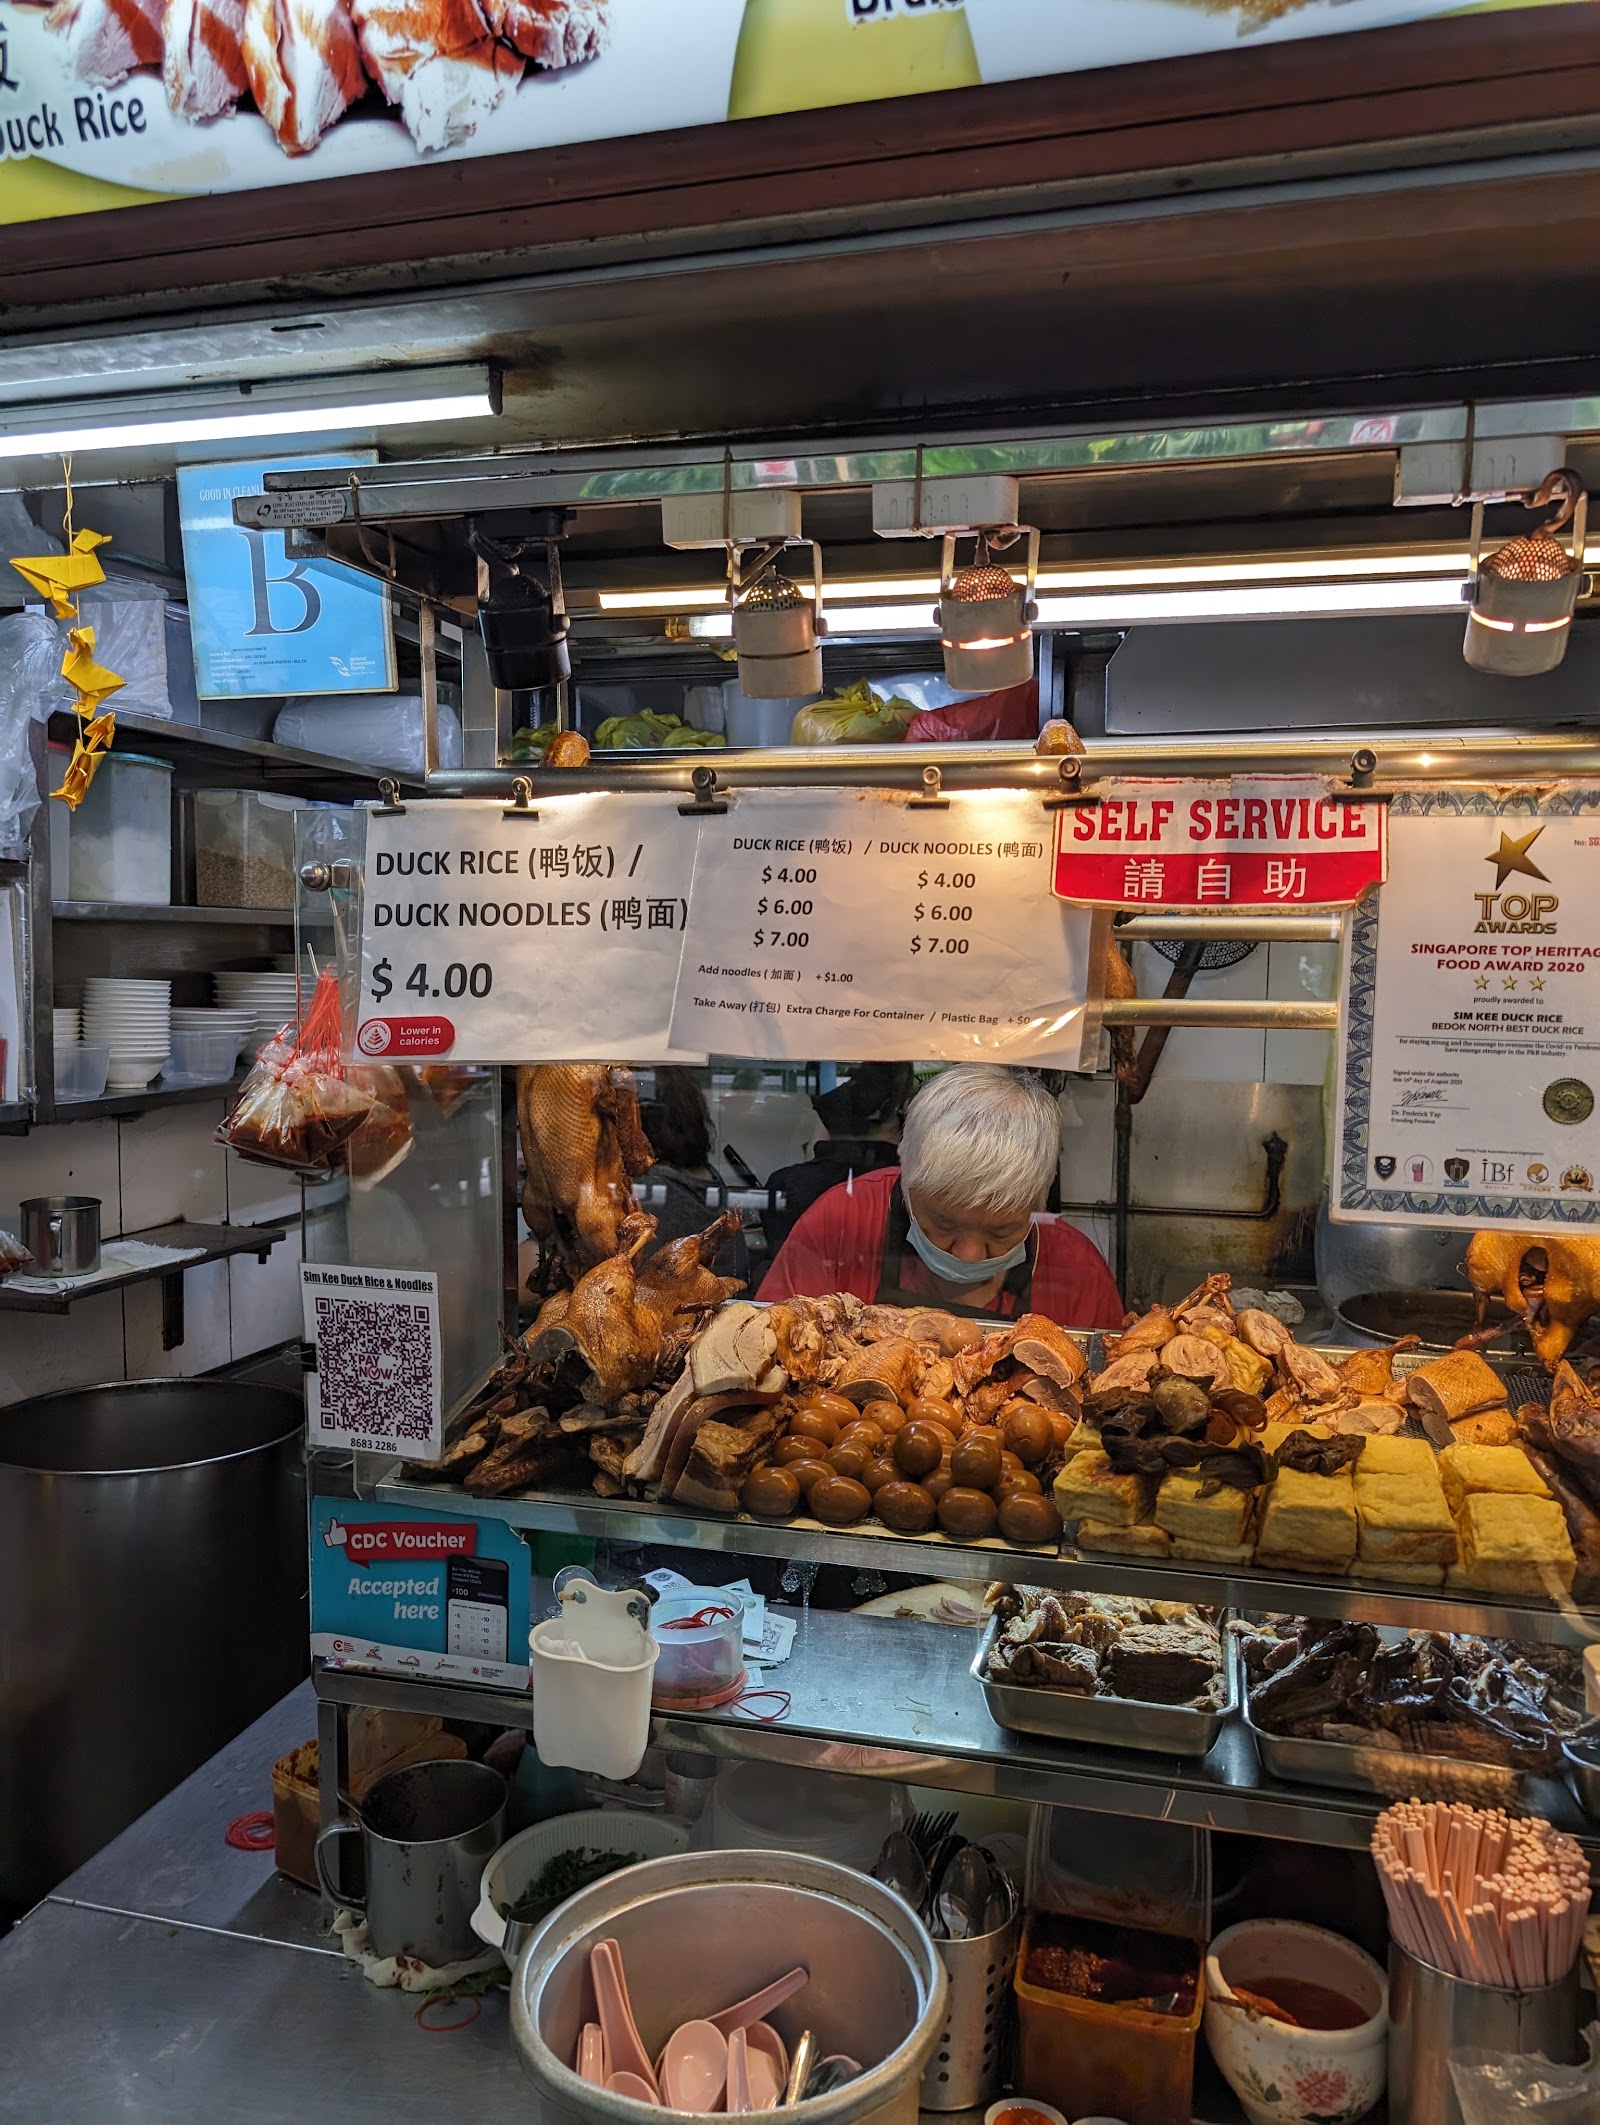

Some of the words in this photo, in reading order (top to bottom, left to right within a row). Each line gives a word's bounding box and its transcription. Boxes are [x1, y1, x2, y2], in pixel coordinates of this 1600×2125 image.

[0, 103, 64, 155] uck
[73, 92, 147, 142] Rice
[199, 488, 221, 502] GOOD
[222, 487, 231, 500] IN
[237, 531, 322, 637] B
[1072, 800, 1174, 841] SELF
[1188, 798, 1366, 841] SERVICE
[733, 838, 772, 850] DUCK
[775, 839, 806, 851] RICE
[809, 838, 853, 855] (鸭饭)
[880, 842, 920, 854] DUCK
[924, 843, 993, 855] NOODLES
[997, 842, 1043, 858] (鸭面)
[376, 851, 450, 876] DUCK
[460, 850, 519, 875] RICE
[528, 844, 615, 880] (鸭饭)
[777, 868, 817, 883] 4.00
[934, 873, 976, 889] 4.00
[1123, 857, 1307, 900] 請自助
[374, 903, 450, 927] DUCK
[459, 902, 592, 927] NOODLES
[600, 896, 689, 931] (鸭面)
[773, 899, 814, 915] 6.00
[931, 905, 973, 922] 6.00
[1474, 892, 1560, 921] TOP
[1473, 921, 1558, 935] AWARDS
[770, 931, 809, 948] 7.00
[927, 938, 970, 954] 7.00
[1411, 943, 1498, 956] SINGAPORE
[1501, 945, 1532, 957] TOP
[698, 964, 720, 975] Add
[721, 967, 761, 978] noodles
[824, 972, 853, 983] $1.00
[1437, 959, 1481, 970] FOOD
[1483, 960, 1544, 972] AWARD
[1547, 961, 1586, 973] 2020
[405, 963, 493, 998] 4.00
[1473, 996, 1501, 1005] proudly
[1502, 997, 1534, 1005] awarded
[1535, 997, 1544, 1005] to
[693, 997, 716, 1008] Take
[718, 1000, 748, 1012] Away
[749, 1001, 781, 1014] (打包)
[786, 1004, 812, 1015] Extra
[815, 1006, 851, 1018] Charge
[853, 1008, 870, 1018] For
[872, 1009, 925, 1021] Container
[941, 1012, 976, 1023] Plastic
[978, 1014, 999, 1026] Bag
[1453, 1011, 1473, 1020] SIM
[1475, 1012, 1499, 1021] KEE
[1501, 1013, 1534, 1022] DUCK
[1536, 1014, 1563, 1023] RICE
[400, 1026, 431, 1036] Lower
[432, 1025, 441, 1035] in
[1431, 1022, 1466, 1031] BEDOK
[1468, 1023, 1504, 1032] NORTH
[1506, 1024, 1530, 1033] BEST
[1532, 1025, 1560, 1034] DUCK
[1562, 1026, 1584, 1035] RICE
[399, 1036, 440, 1046] calories
[1392, 1069, 1411, 1077] Signed
[303, 1271, 321, 1283] Sim
[322, 1272, 339, 1284] Kee
[340, 1273, 364, 1286] Duck
[364, 1275, 385, 1288] Rice
[386, 1277, 394, 1288] &
[394, 1277, 434, 1291] Noodles
[358, 1355, 381, 1368] PAY
[350, 1437, 373, 1449] 8683
[375, 1440, 398, 1452] 2286
[350, 1532, 388, 1549] CDC
[391, 1531, 466, 1549] Voucher
[347, 1577, 440, 1599] Accepted
[393, 1601, 440, 1620] here
